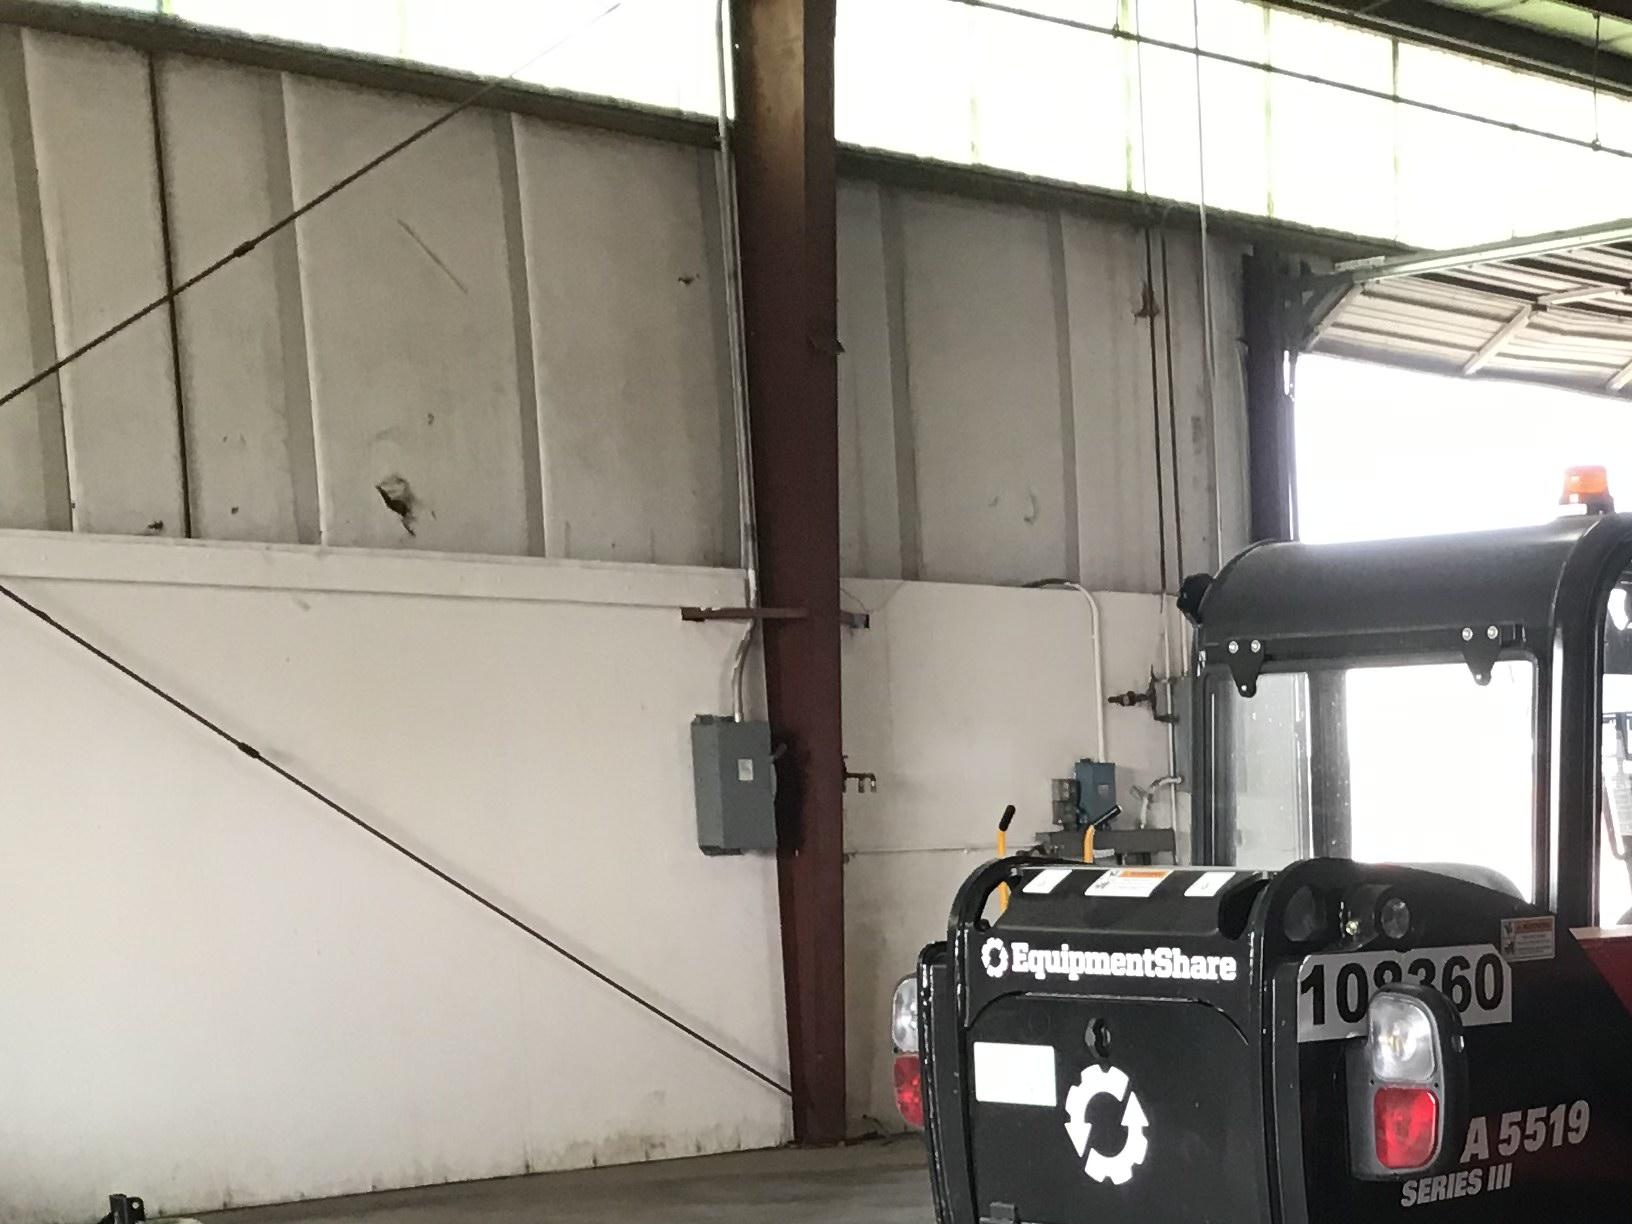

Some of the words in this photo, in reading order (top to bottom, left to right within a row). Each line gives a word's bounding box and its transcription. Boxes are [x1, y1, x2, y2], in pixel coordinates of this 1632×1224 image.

[1010, 942, 1238, 981] EquipmentShare
[1498, 1100, 1591, 1157] 5519
[1401, 1167, 1483, 1208] SERIES
[1487, 1163, 1513, 1192] III
